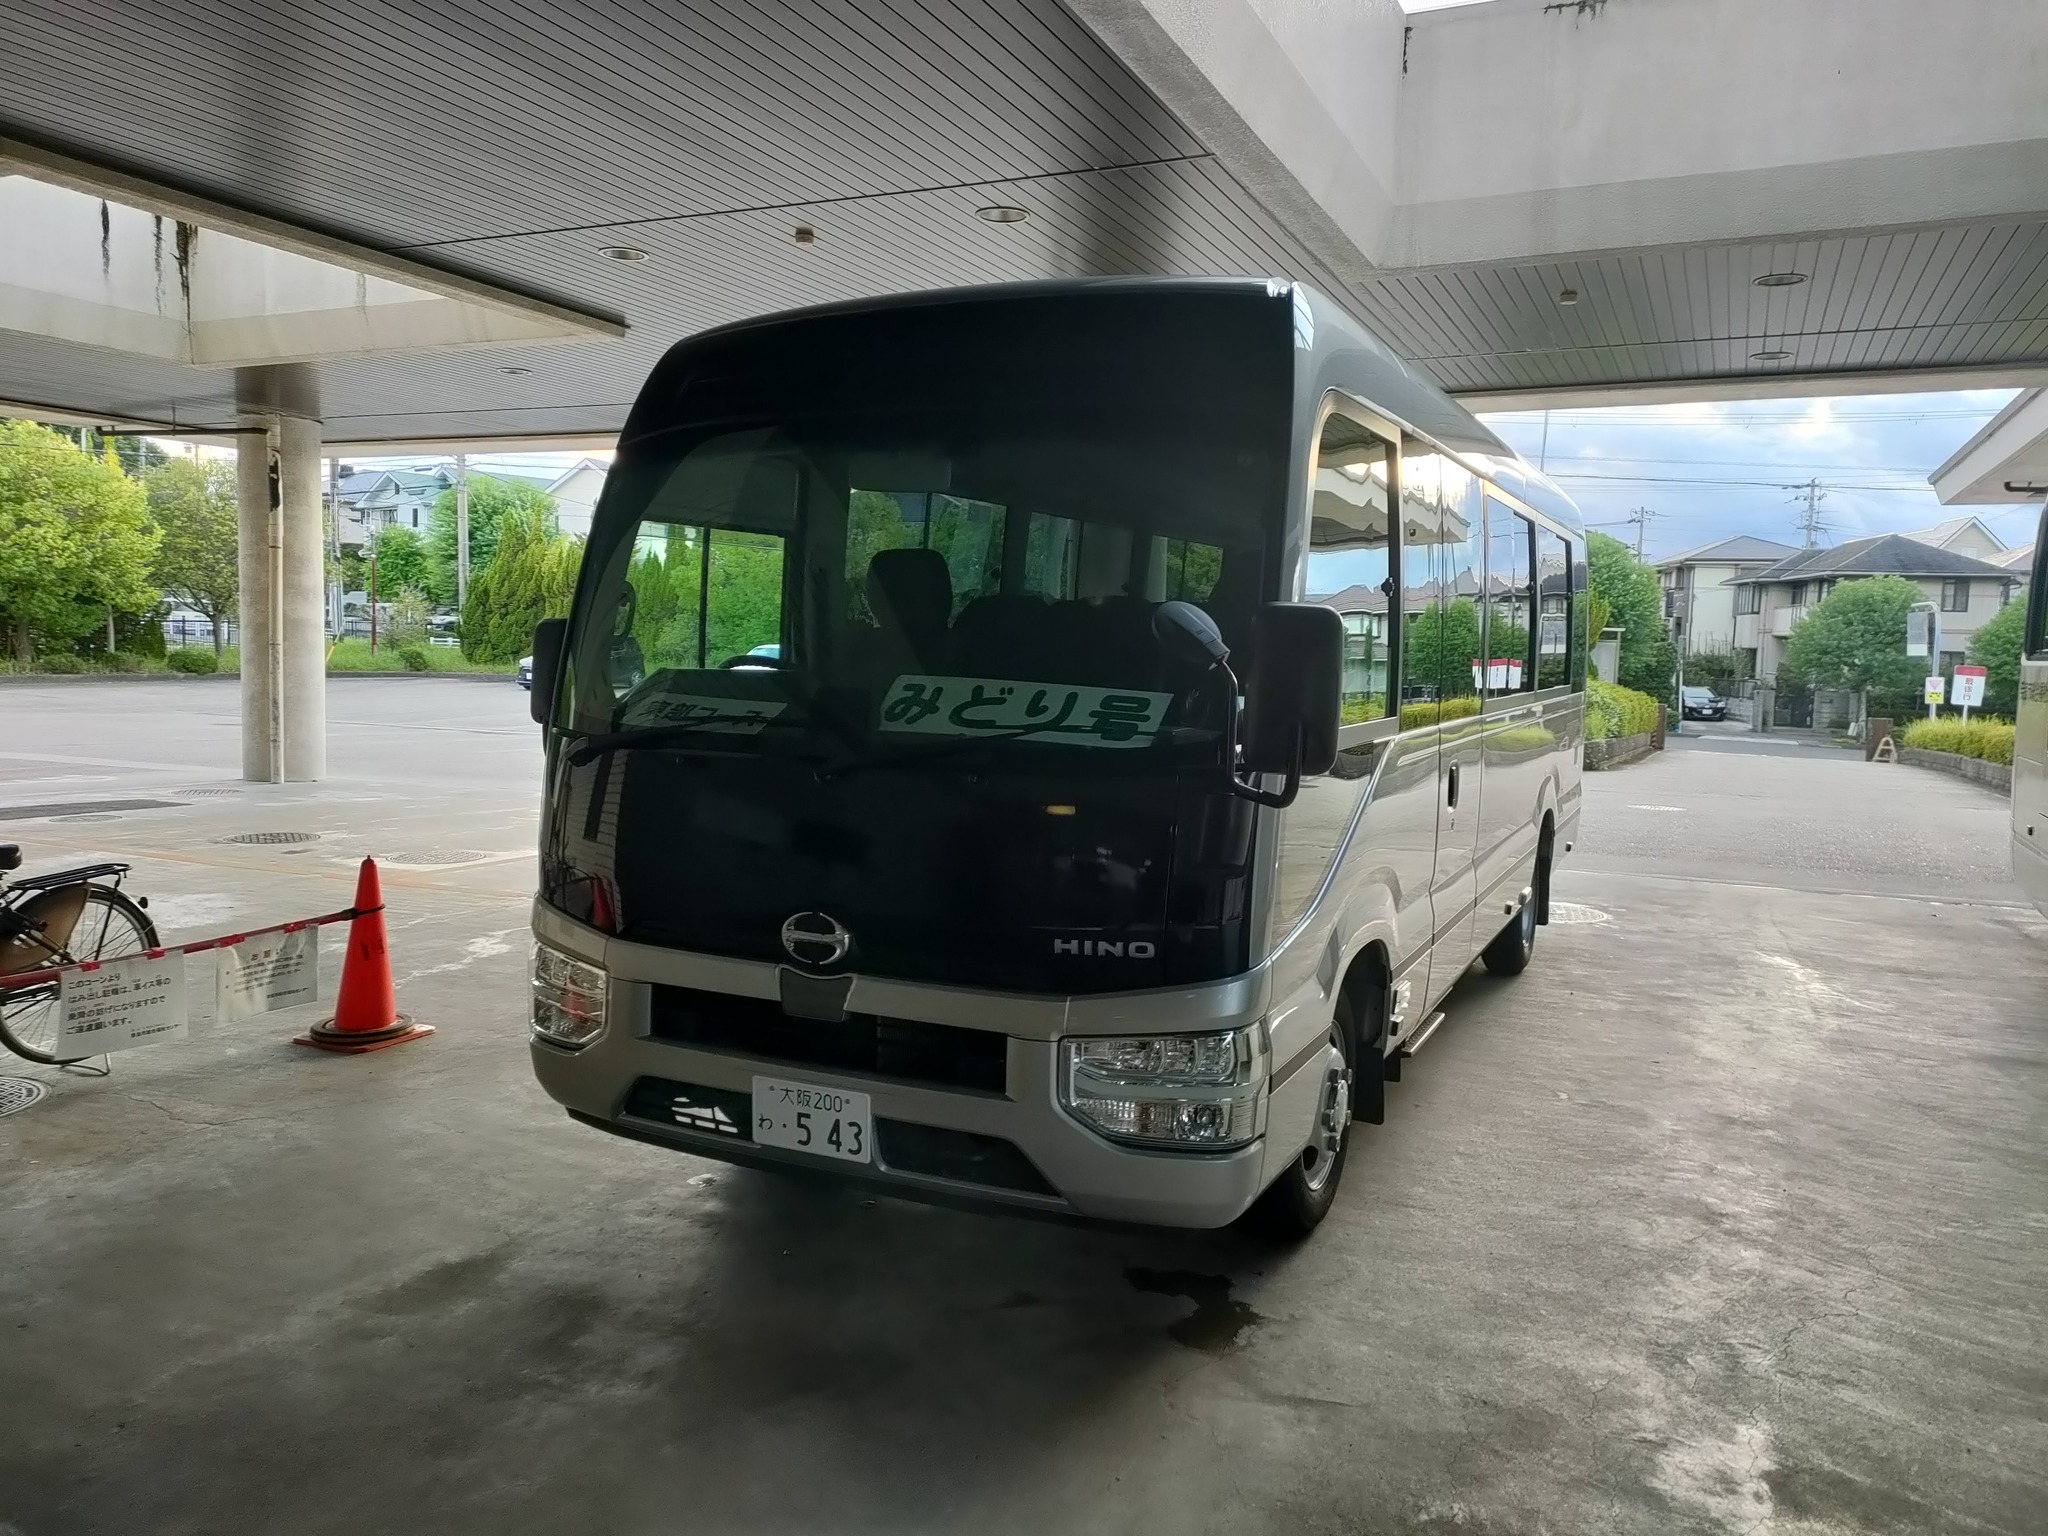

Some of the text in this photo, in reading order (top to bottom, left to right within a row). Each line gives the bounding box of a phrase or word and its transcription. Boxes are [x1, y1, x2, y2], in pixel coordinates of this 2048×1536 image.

[637, 699, 765, 727] 東部コス
[884, 682, 1152, 742] みどり号
[1054, 938, 1155, 960] HINO
[67, 973, 121, 990] このコーンより
[779, 1088, 843, 1113] 大阪200
[758, 1113, 773, 1131] わ
